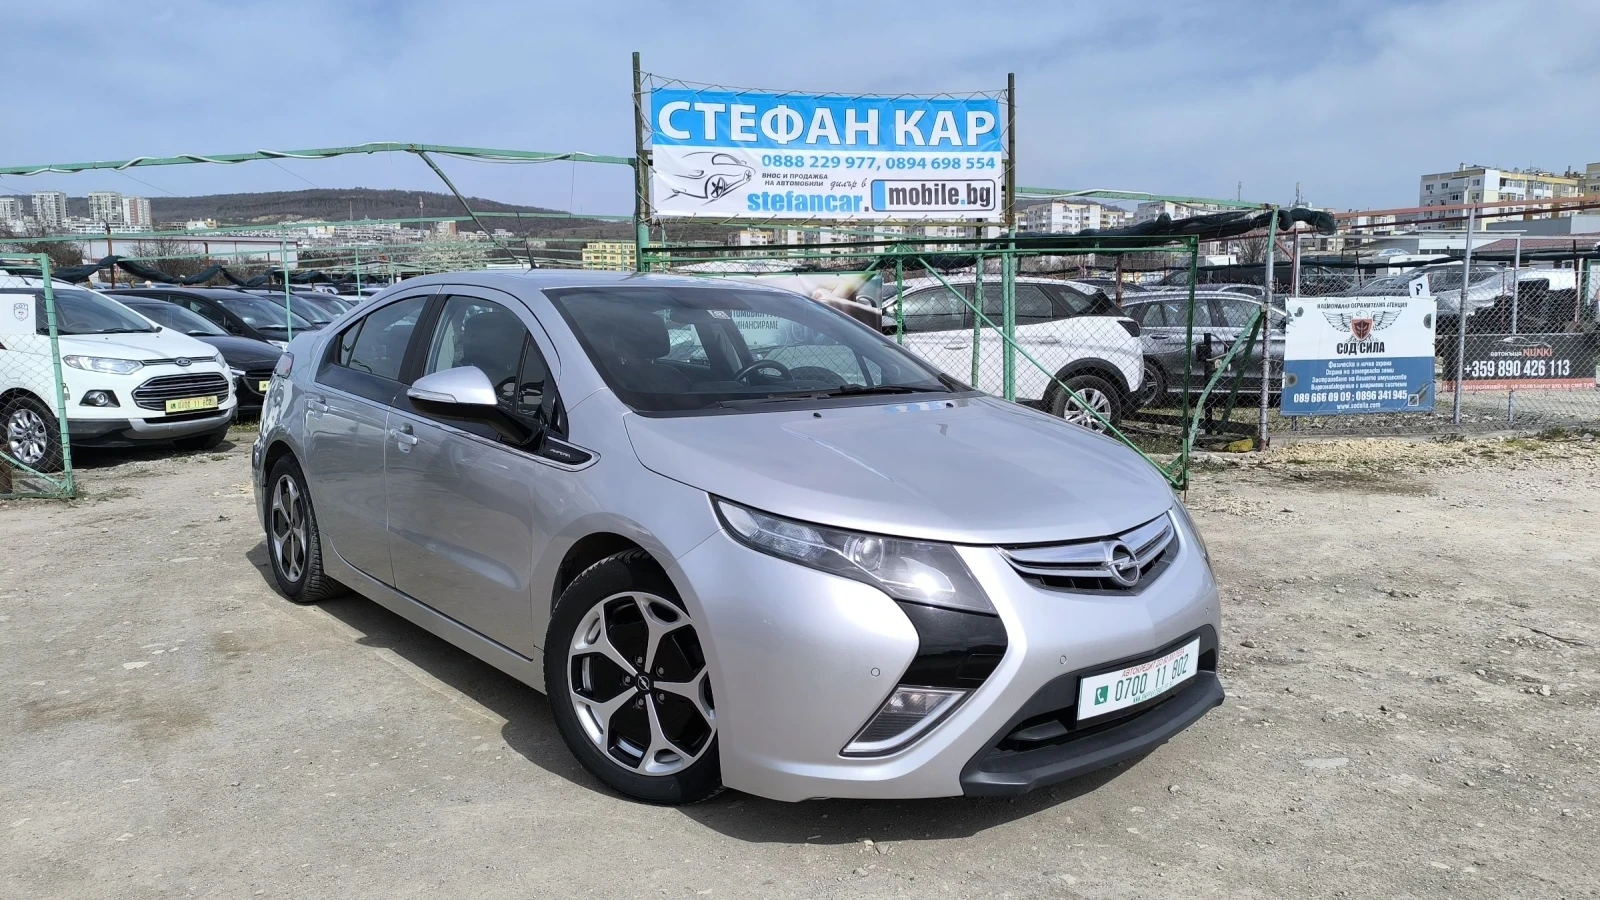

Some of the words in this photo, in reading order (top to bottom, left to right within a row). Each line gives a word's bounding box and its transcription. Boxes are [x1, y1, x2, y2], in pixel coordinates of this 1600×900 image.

[657, 100, 880, 146] СТЕФАН
[895, 108, 996, 147] КАР
[761, 154, 805, 168] 0888
[809, 155, 841, 169] 229
[845, 156, 881, 171] 977,
[885, 155, 927, 169] 0894
[930, 156, 962, 170] 698
[965, 156, 996, 170] 554
[888, 183, 991, 208] mobile.bg
[735, 320, 779, 330] ИНАНСИРАМЕ
[1336, 342, 1358, 355] СОД
[1360, 341, 1385, 354] СИЛА
[1523, 347, 1552, 357] NUNKI
[1464, 360, 1495, 377] +359
[1498, 360, 1521, 377] 890
[1523, 359, 1546, 376] 426
[1549, 359, 1570, 376] 113
[1293, 393, 1310, 403] 089
[1311, 392, 1327, 403] 666
[1328, 391, 1339, 402] 09
[1356, 390, 1377, 401] 0896
[1378, 390, 1392, 400] 341
[1393, 389, 1408, 400] 945
[1115, 672, 1148, 702] 0700
[1155, 664, 1167, 688] 11
[1172, 653, 1189, 680] 802
